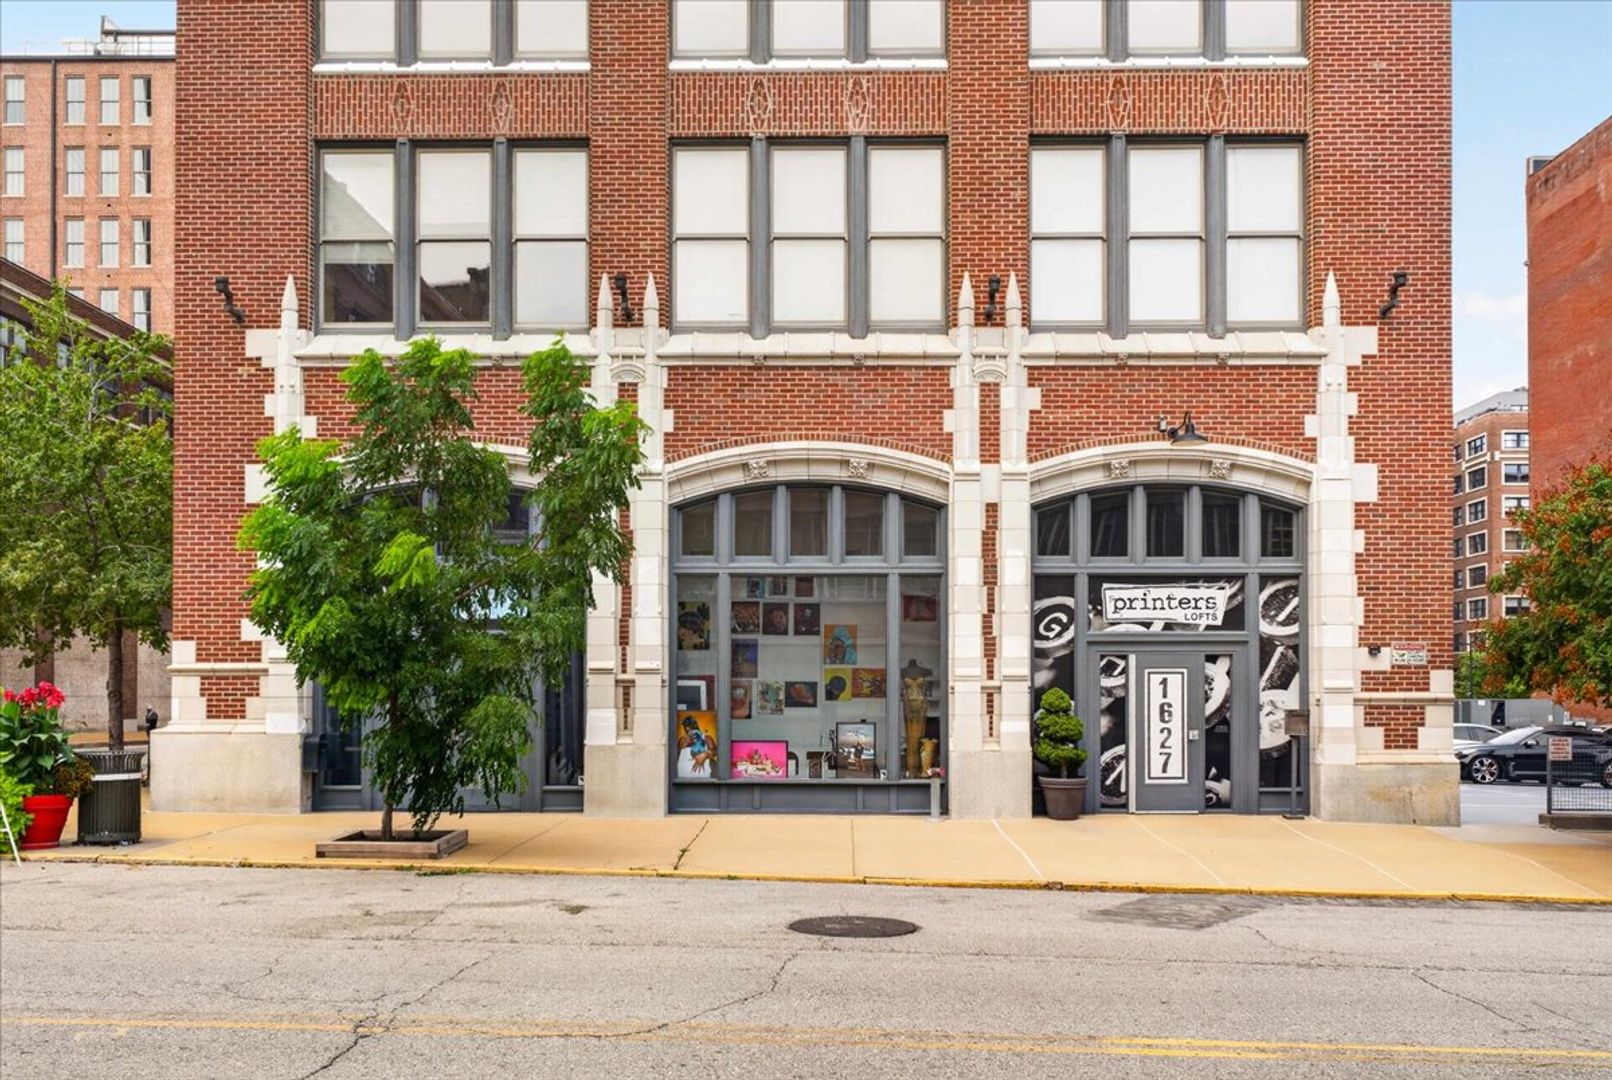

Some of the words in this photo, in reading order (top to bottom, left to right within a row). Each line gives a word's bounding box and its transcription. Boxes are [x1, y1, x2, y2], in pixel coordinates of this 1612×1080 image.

[1110, 591, 1217, 614] printers
[1183, 612, 1218, 621] LOFTS
[1158, 677, 1173, 774] 1627
